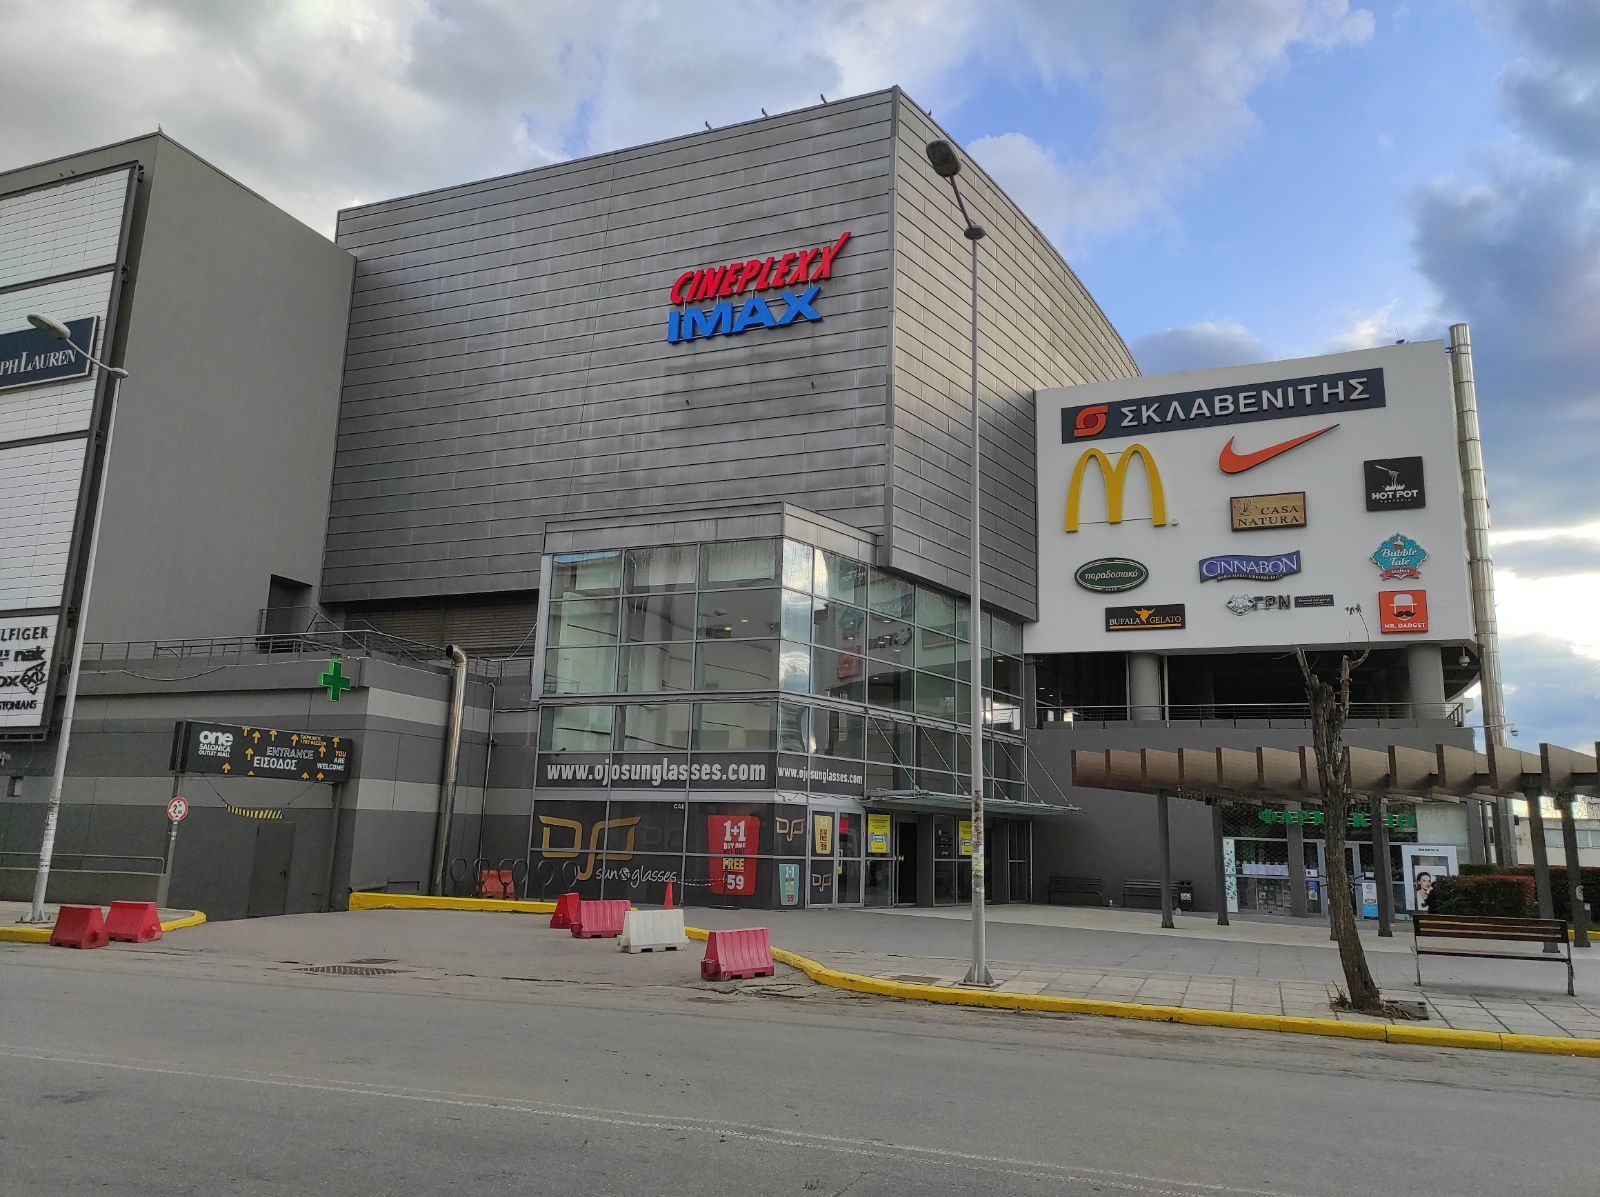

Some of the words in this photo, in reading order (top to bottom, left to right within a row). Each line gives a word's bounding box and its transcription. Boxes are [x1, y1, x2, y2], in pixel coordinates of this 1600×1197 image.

[670, 231, 851, 304] CINEPLEXX
[667, 286, 823, 344] IMAX
[19, 349, 77, 373] LAUREN
[1120, 377, 1370, 427] ΣΚΛΑΒΕΝΙΤΗΣ
[1371, 491, 1394, 500] HOT
[1396, 489, 1419, 498] POT
[1260, 505, 1300, 515] CASA
[1238, 515, 1300, 527] NATURA
[1202, 555, 1297, 577] CINNABON
[1109, 617, 1141, 626] BUFALA
[1149, 615, 1182, 624] GELATO
[199, 730, 234, 746] one
[198, 743, 231, 753] SALONICA
[266, 746, 315, 760] ENTRANCE
[335, 750, 347, 758] YOU
[253, 756, 298, 770] ΕΙΣΟΔΟΣ
[316, 762, 345, 771] WELCOME
[547, 757, 766, 786] www.ojosunglasses.com
[723, 820, 746, 842] 1+1
[726, 874, 745, 890] 59
